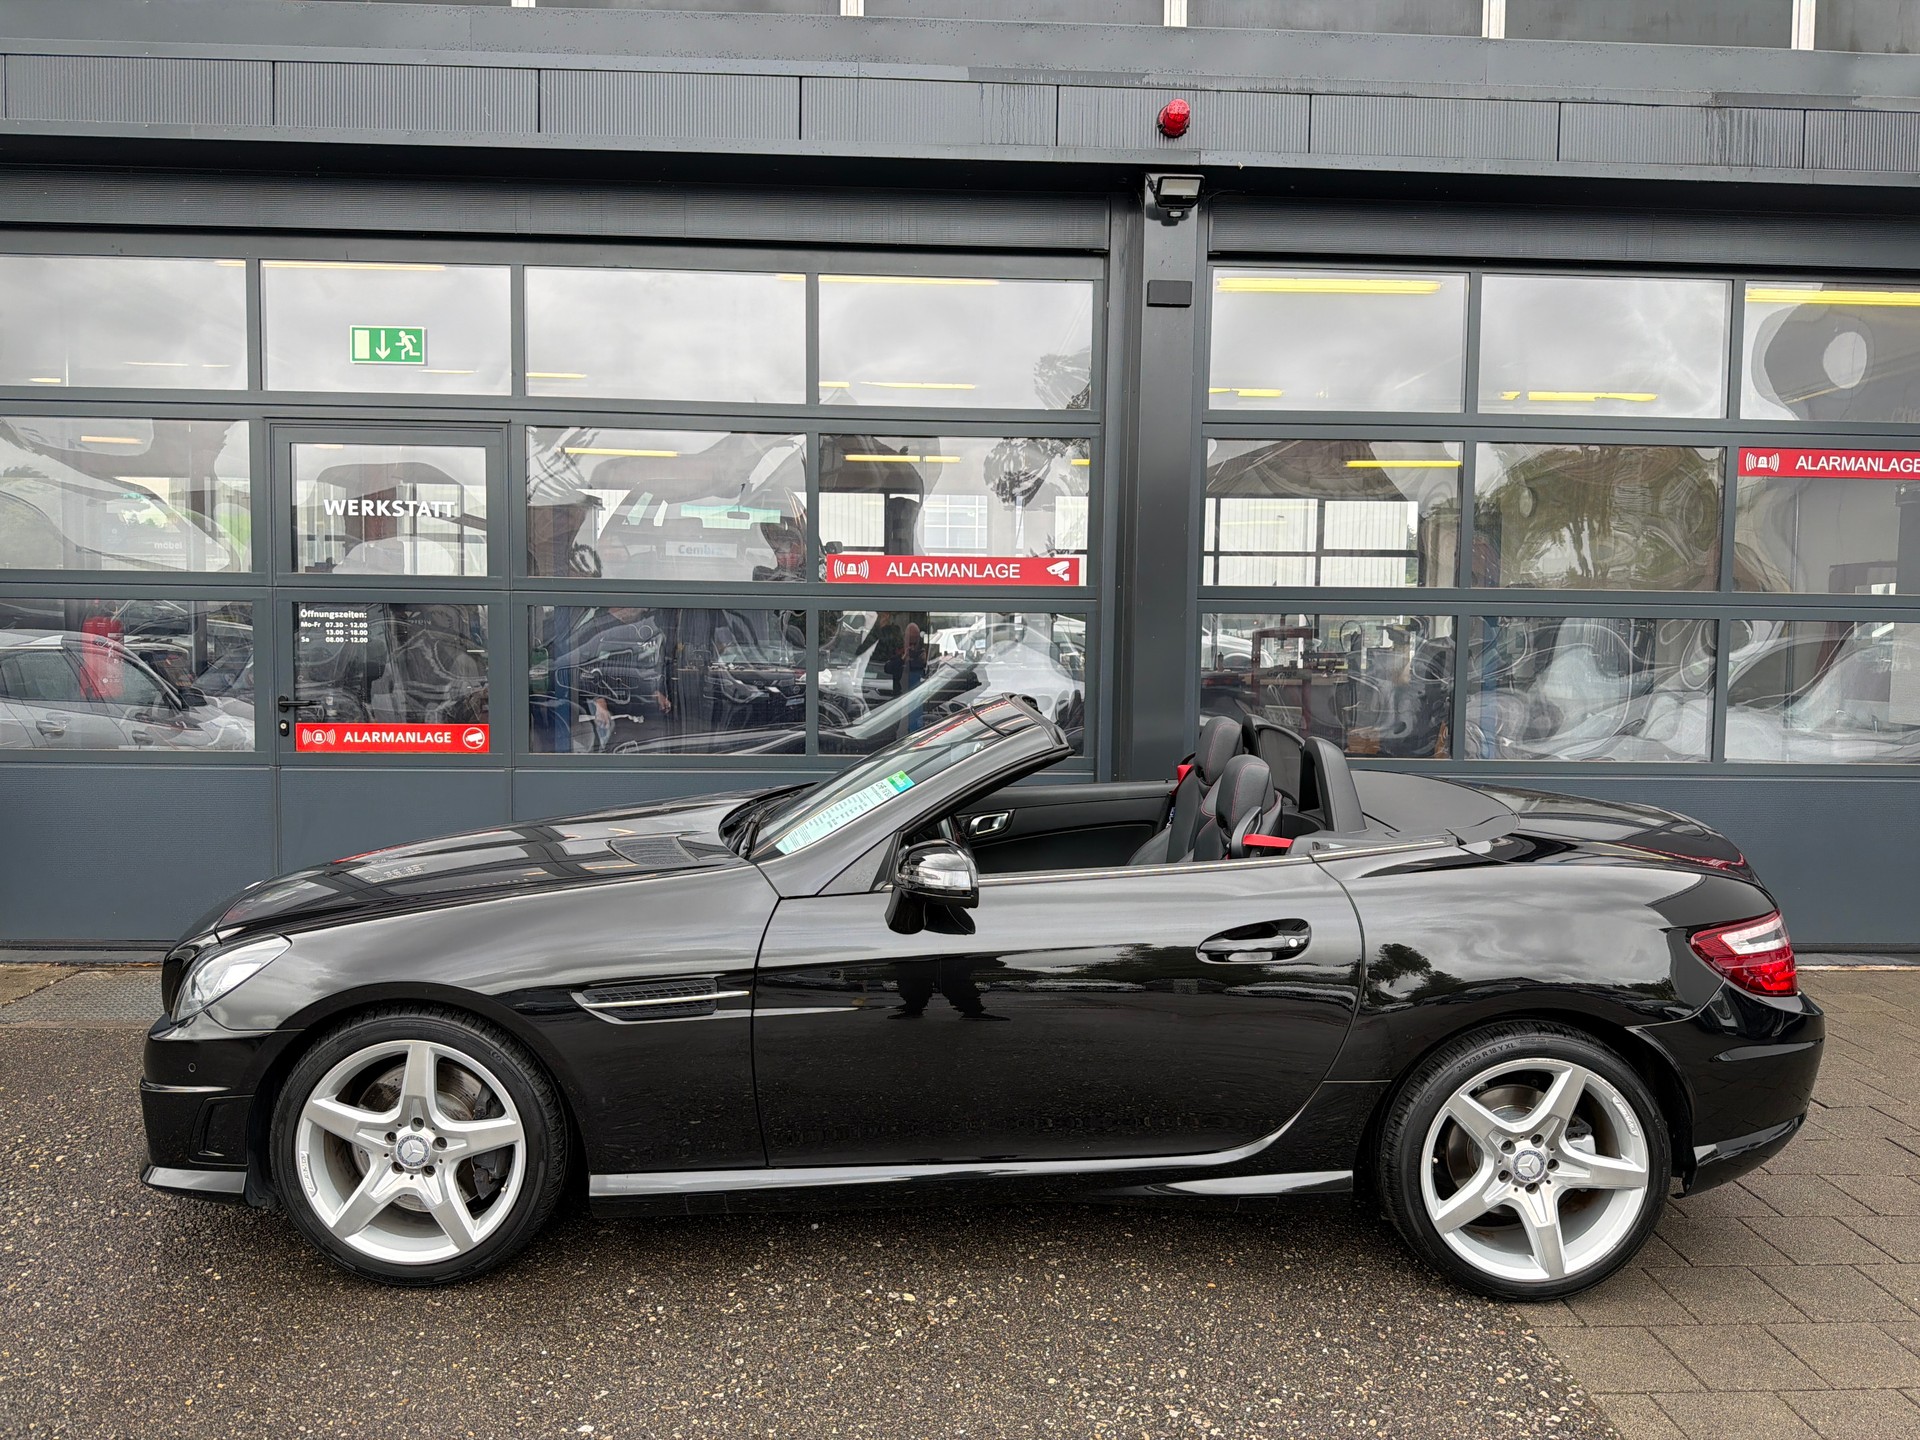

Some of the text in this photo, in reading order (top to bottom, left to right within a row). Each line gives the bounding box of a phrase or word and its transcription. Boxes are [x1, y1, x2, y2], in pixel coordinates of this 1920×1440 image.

[1795, 455, 1920, 473] ALARMANLAGE
[323, 499, 457, 518] WERKSTATT
[886, 562, 1021, 579] ALARMANLAGE
[300, 609, 368, 620] Öffnungszeiten:
[343, 731, 452, 744] ALARMANLAGE
[1456, 1055, 1481, 1072] 245/35
